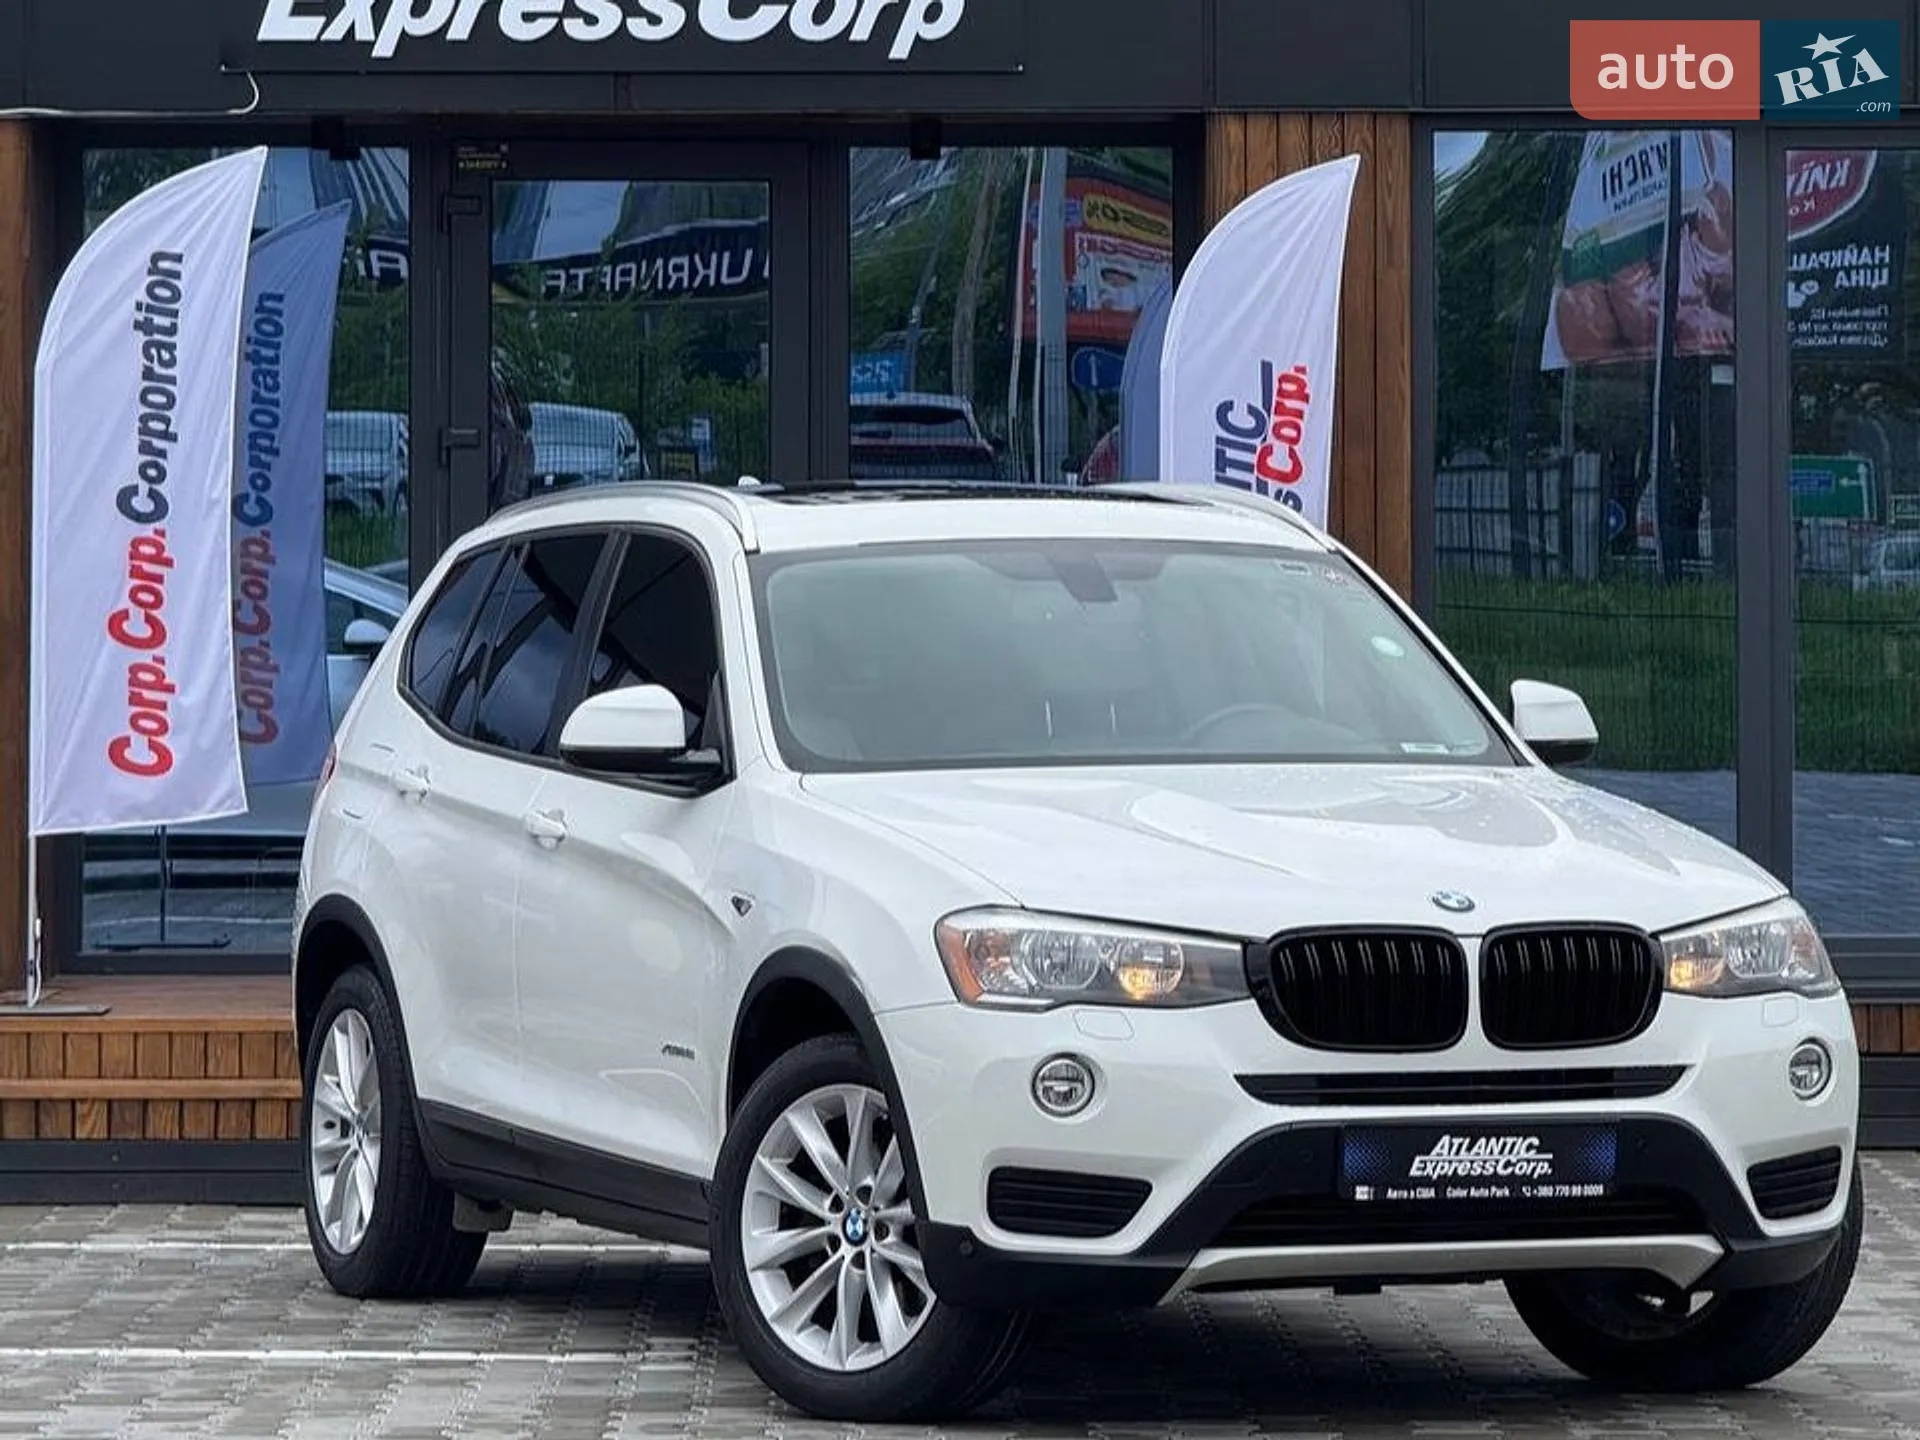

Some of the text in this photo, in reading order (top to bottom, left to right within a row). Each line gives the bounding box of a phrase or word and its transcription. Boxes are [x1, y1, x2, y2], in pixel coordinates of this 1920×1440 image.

[1428, 1134, 1540, 1158] ATLANTIC
[1409, 1155, 1554, 1180] ExpressCorp.
[1490, 1185, 1510, 1199] Park
